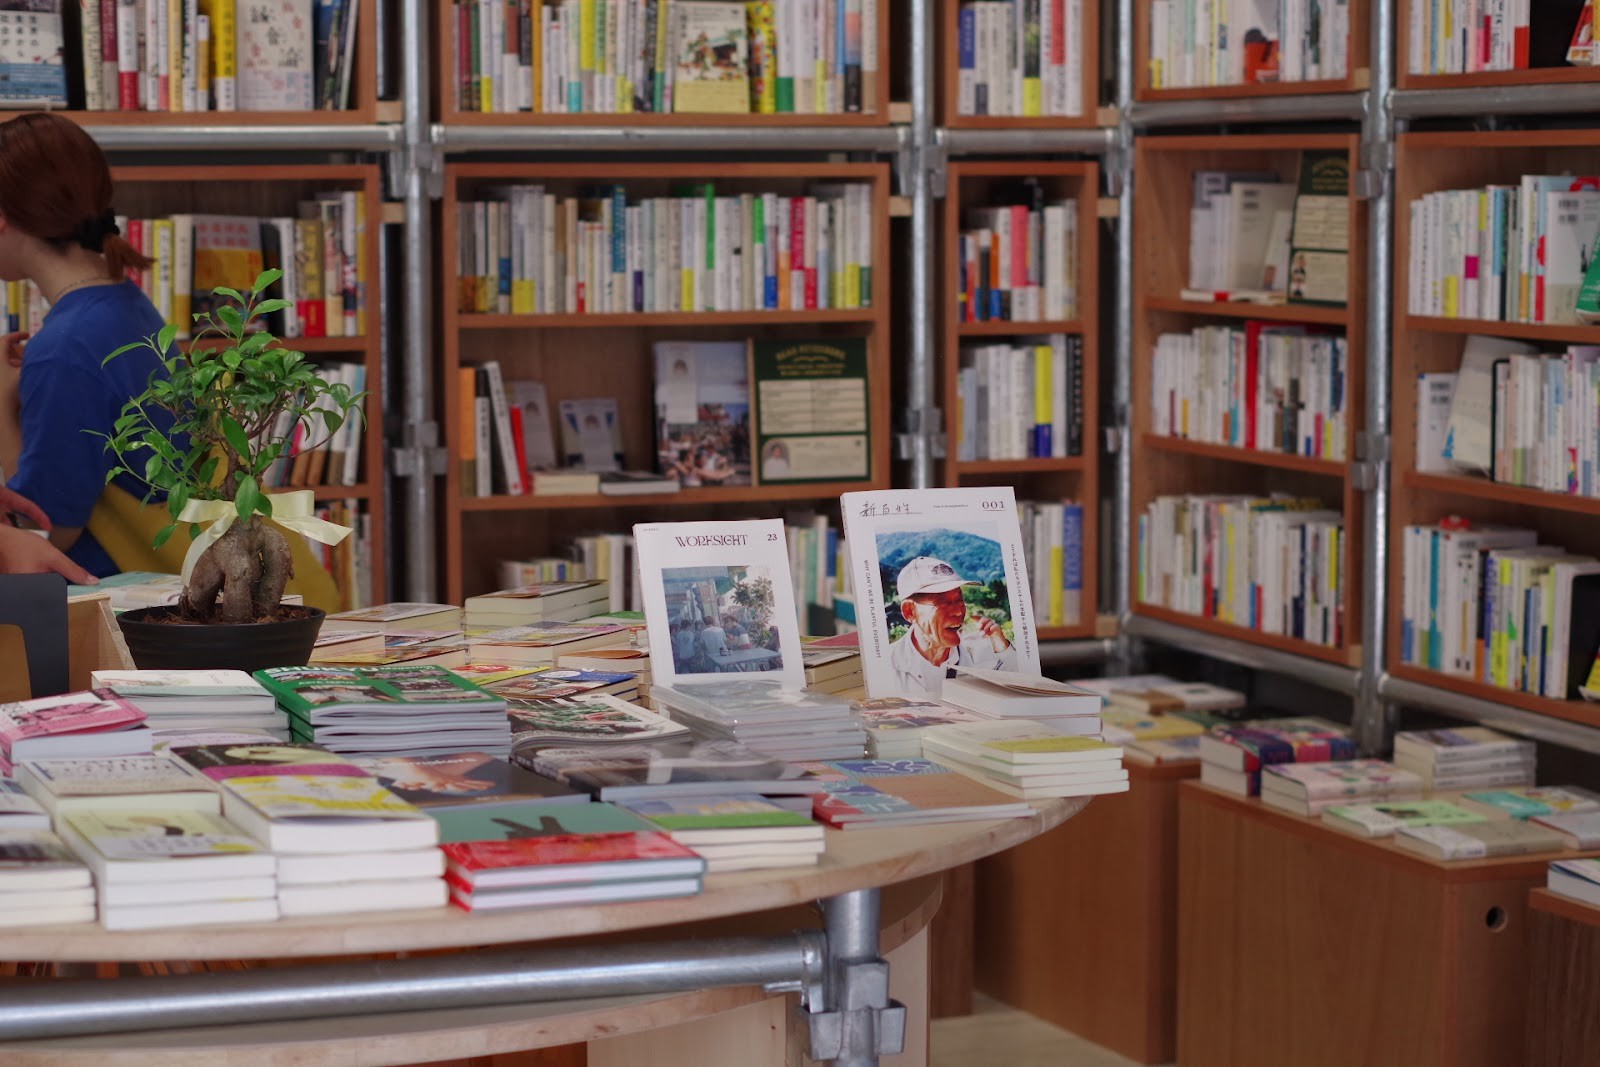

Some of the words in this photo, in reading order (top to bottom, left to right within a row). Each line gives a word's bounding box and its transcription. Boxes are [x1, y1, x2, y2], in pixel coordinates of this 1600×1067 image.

[981, 500, 1006, 510] 001
[675, 534, 749, 548] WORKSIGHT
[767, 533, 778, 542] 23
